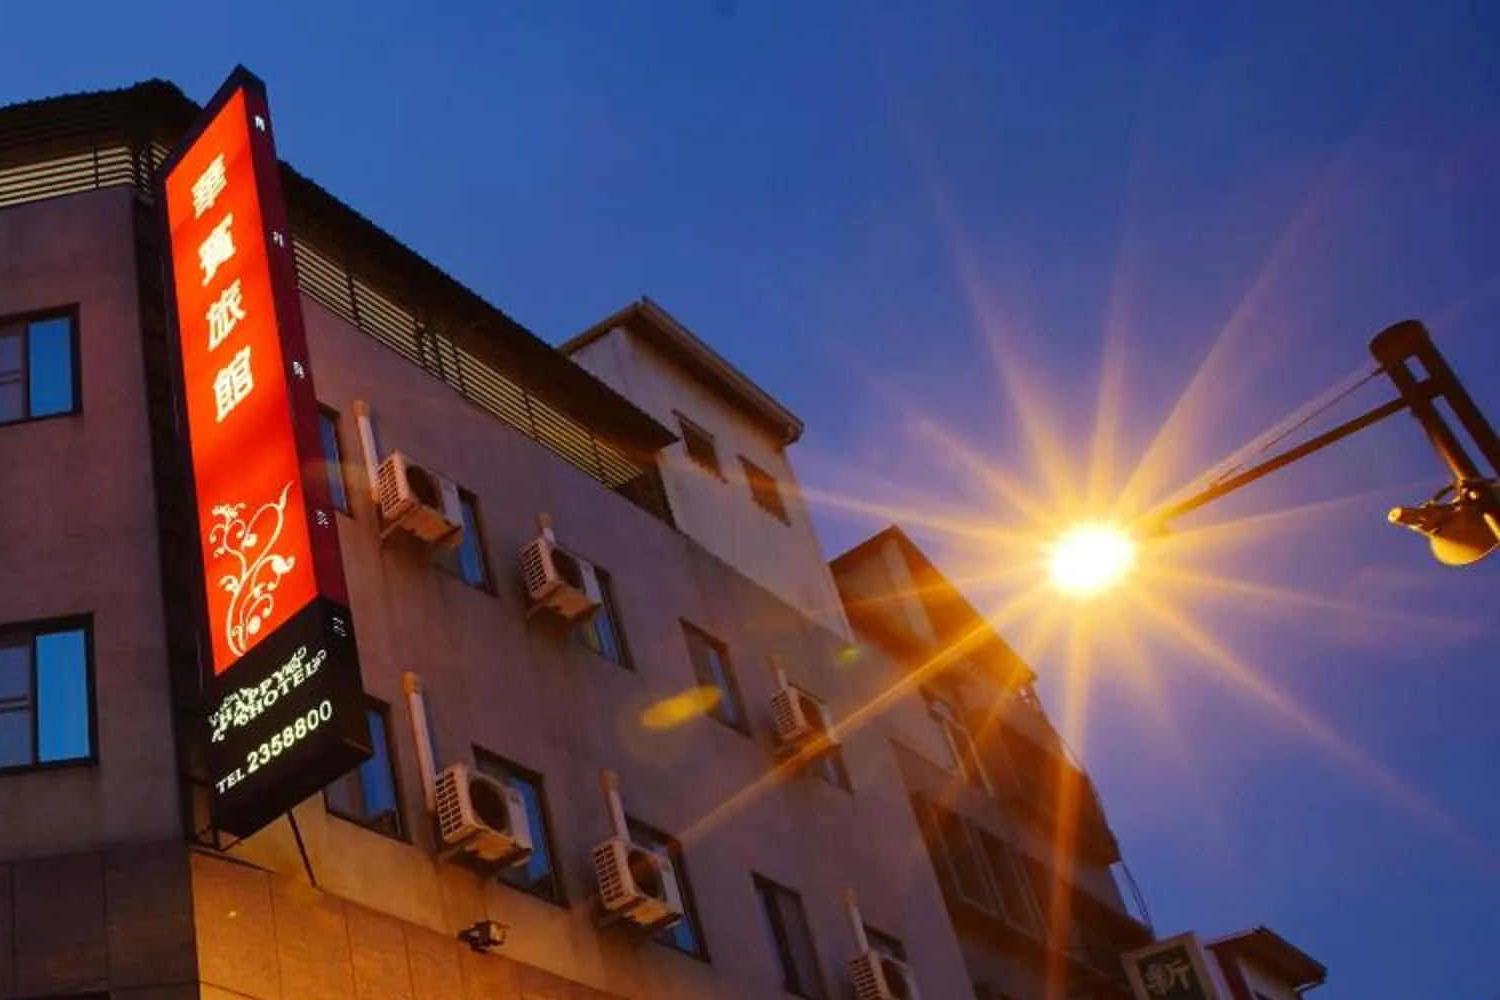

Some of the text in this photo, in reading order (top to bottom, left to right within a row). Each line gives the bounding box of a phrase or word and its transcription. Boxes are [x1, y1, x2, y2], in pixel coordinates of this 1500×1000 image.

[191, 153, 254, 423] 華賓旅館
[216, 700, 332, 793] TEL 2358800
